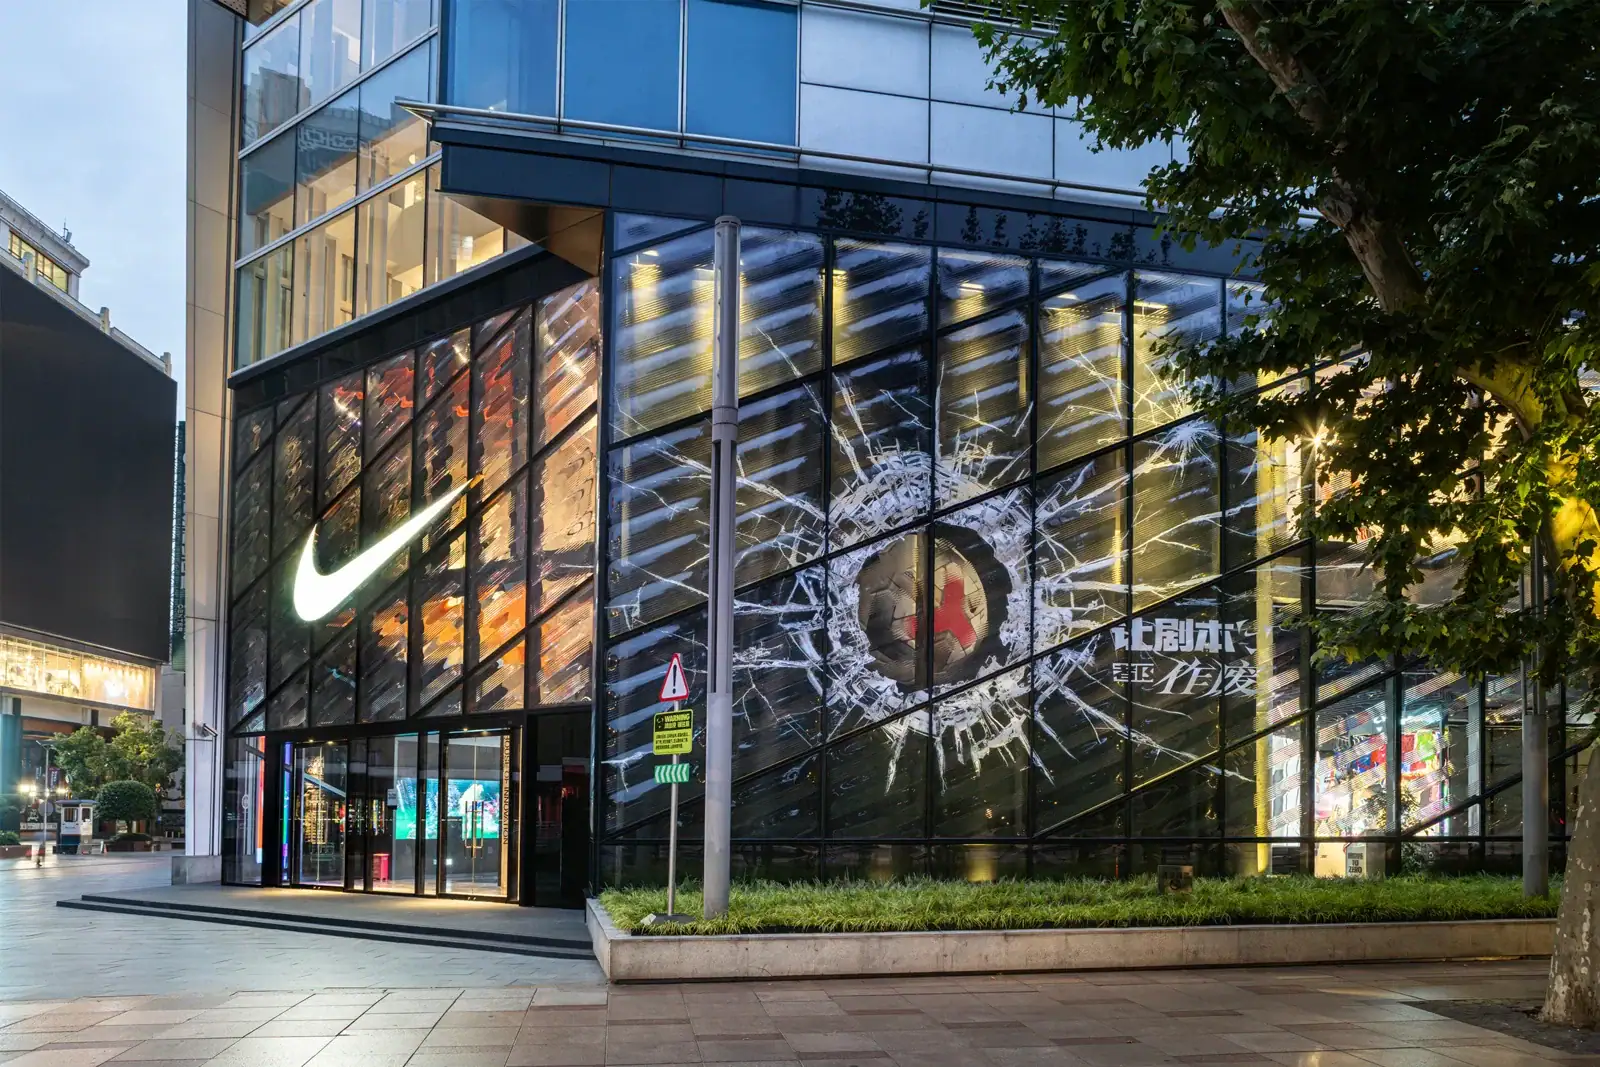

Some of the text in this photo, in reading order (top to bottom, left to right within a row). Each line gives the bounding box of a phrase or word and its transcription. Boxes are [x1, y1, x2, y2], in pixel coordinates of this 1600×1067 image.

[1111, 617, 1235, 653] 让剧本
[664, 713, 690, 722] WARNING
[503, 771, 510, 784] OF
